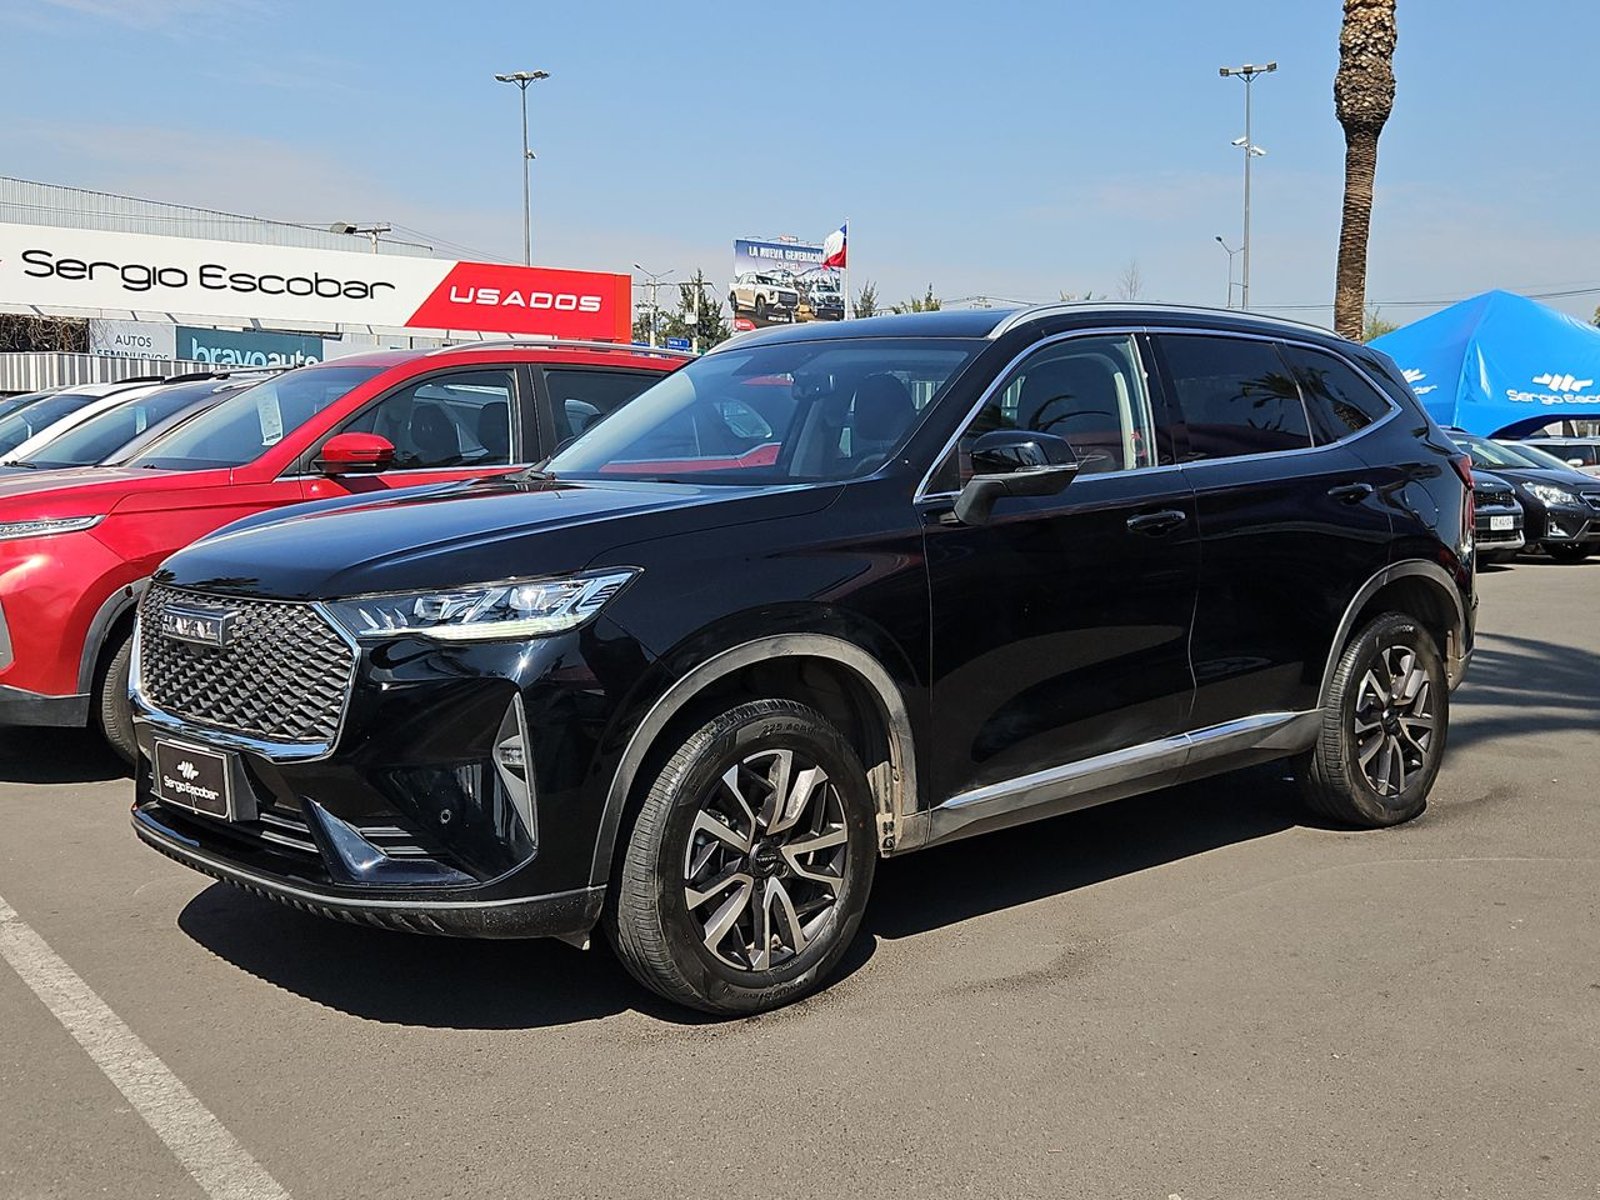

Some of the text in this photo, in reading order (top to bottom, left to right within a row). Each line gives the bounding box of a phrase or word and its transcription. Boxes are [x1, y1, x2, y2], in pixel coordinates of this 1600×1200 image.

[748, 245, 759, 257] LA
[760, 247, 784, 260] NUEVA
[22, 249, 396, 300] Sergio Escobar
[450, 285, 602, 312] USADOS
[115, 334, 152, 348] AUTOS
[191, 337, 319, 366] bravoauto
